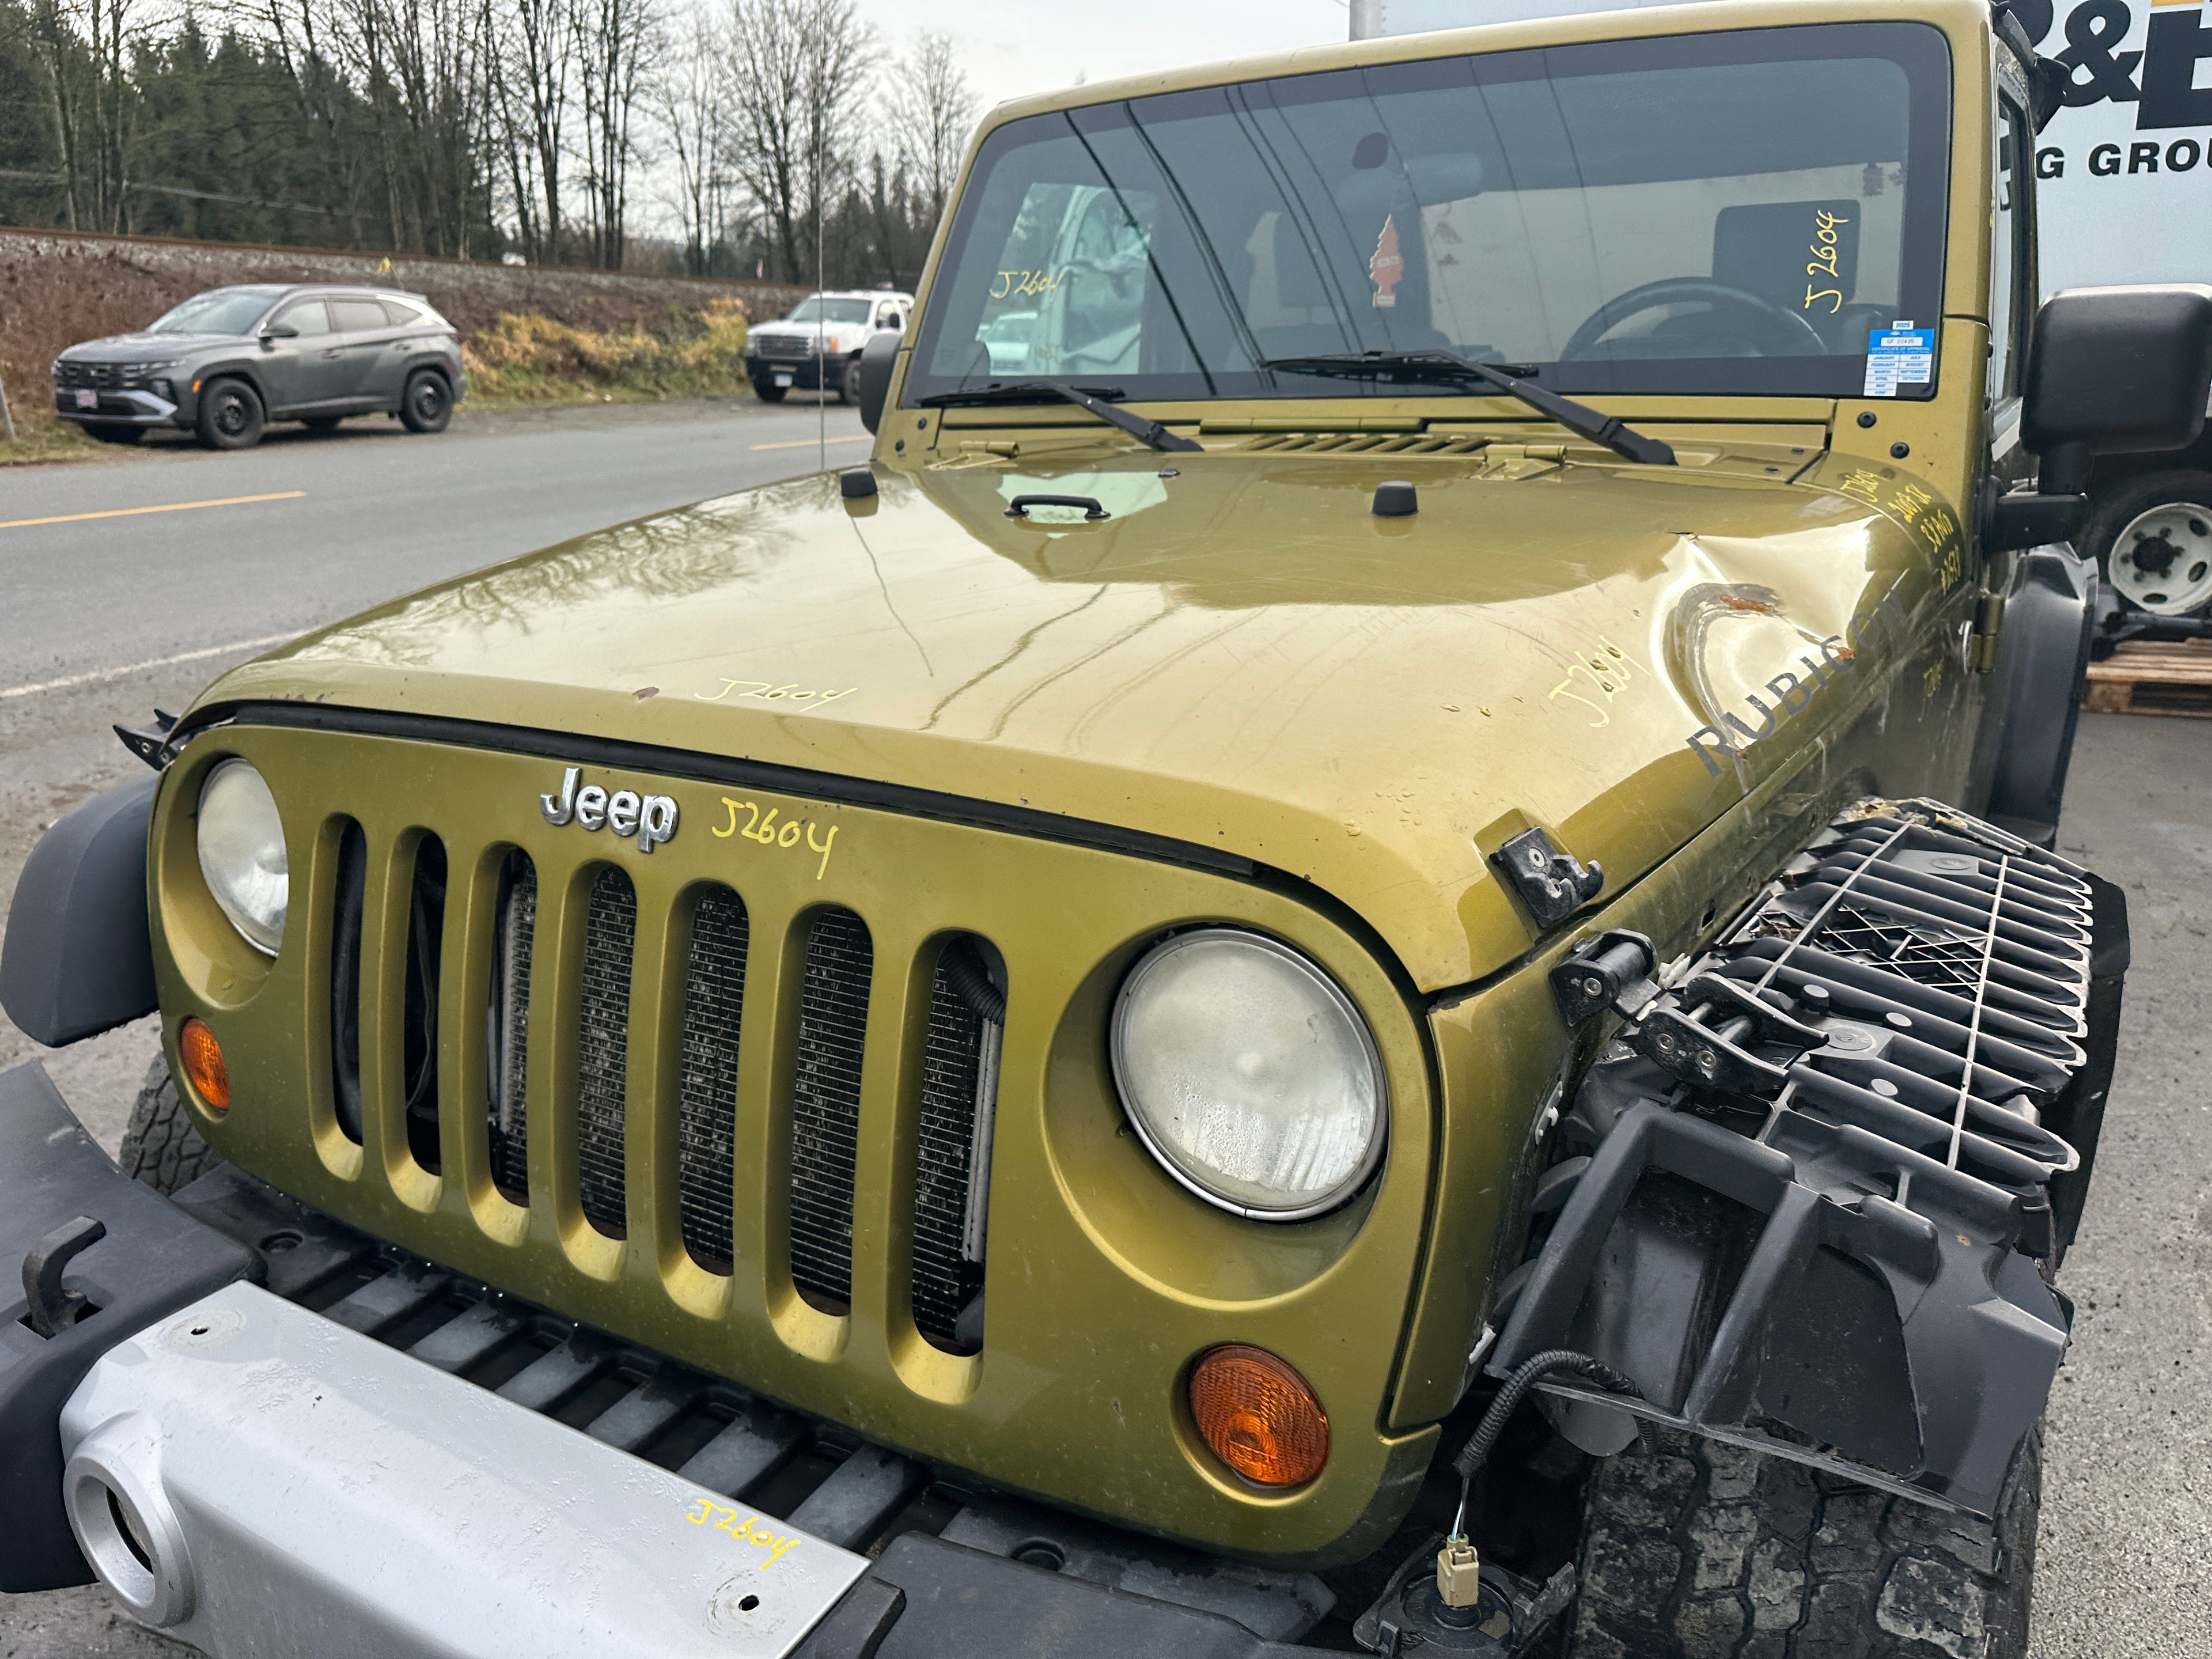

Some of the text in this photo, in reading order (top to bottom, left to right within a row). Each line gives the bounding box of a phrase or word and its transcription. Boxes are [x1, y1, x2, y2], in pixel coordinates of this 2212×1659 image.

[2088, 138, 2212, 176] GRO
[1804, 209, 1849, 313] J2604
[693, 677, 858, 713] J2604
[540, 767, 680, 854] Jeep
[712, 797, 839, 880] J2604
[685, 1498, 801, 1571] J2604
